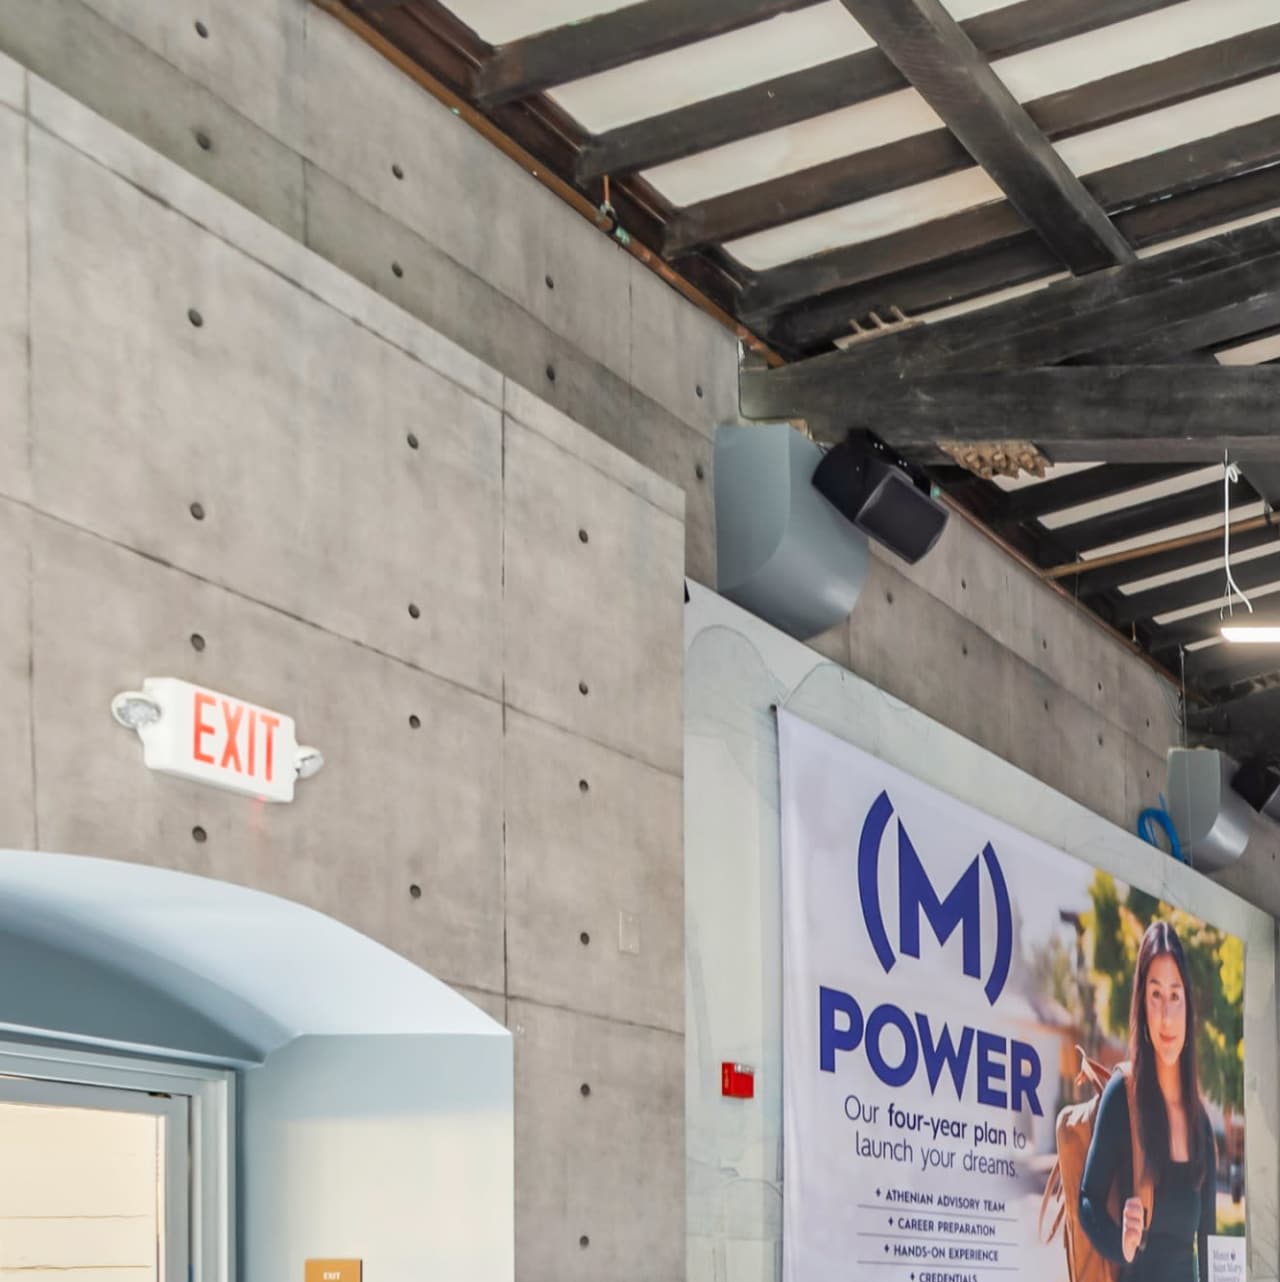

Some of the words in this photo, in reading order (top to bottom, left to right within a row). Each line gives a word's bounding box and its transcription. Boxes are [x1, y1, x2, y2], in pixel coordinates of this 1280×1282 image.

[193, 691, 280, 782] EXIT
[819, 985, 1044, 1118] POWER
[844, 1094, 880, 1125] Our
[887, 1102, 968, 1140] four-year
[974, 1121, 1007, 1147] plan
[1012, 1127, 1027, 1150] to
[855, 1131, 914, 1163] launch
[920, 1145, 956, 1172] your
[962, 1149, 1019, 1179] dreams.
[885, 1188, 934, 1205] ATHENIAN
[937, 1194, 980, 1211] ADVISORY
[983, 1201, 1006, 1213] TEAM
[897, 1217, 935, 1232] CAREER
[937, 1221, 996, 1237] PREPARATION
[893, 1244, 946, 1258] HANDS-ON
[949, 1249, 999, 1262] EXPERIENCE
